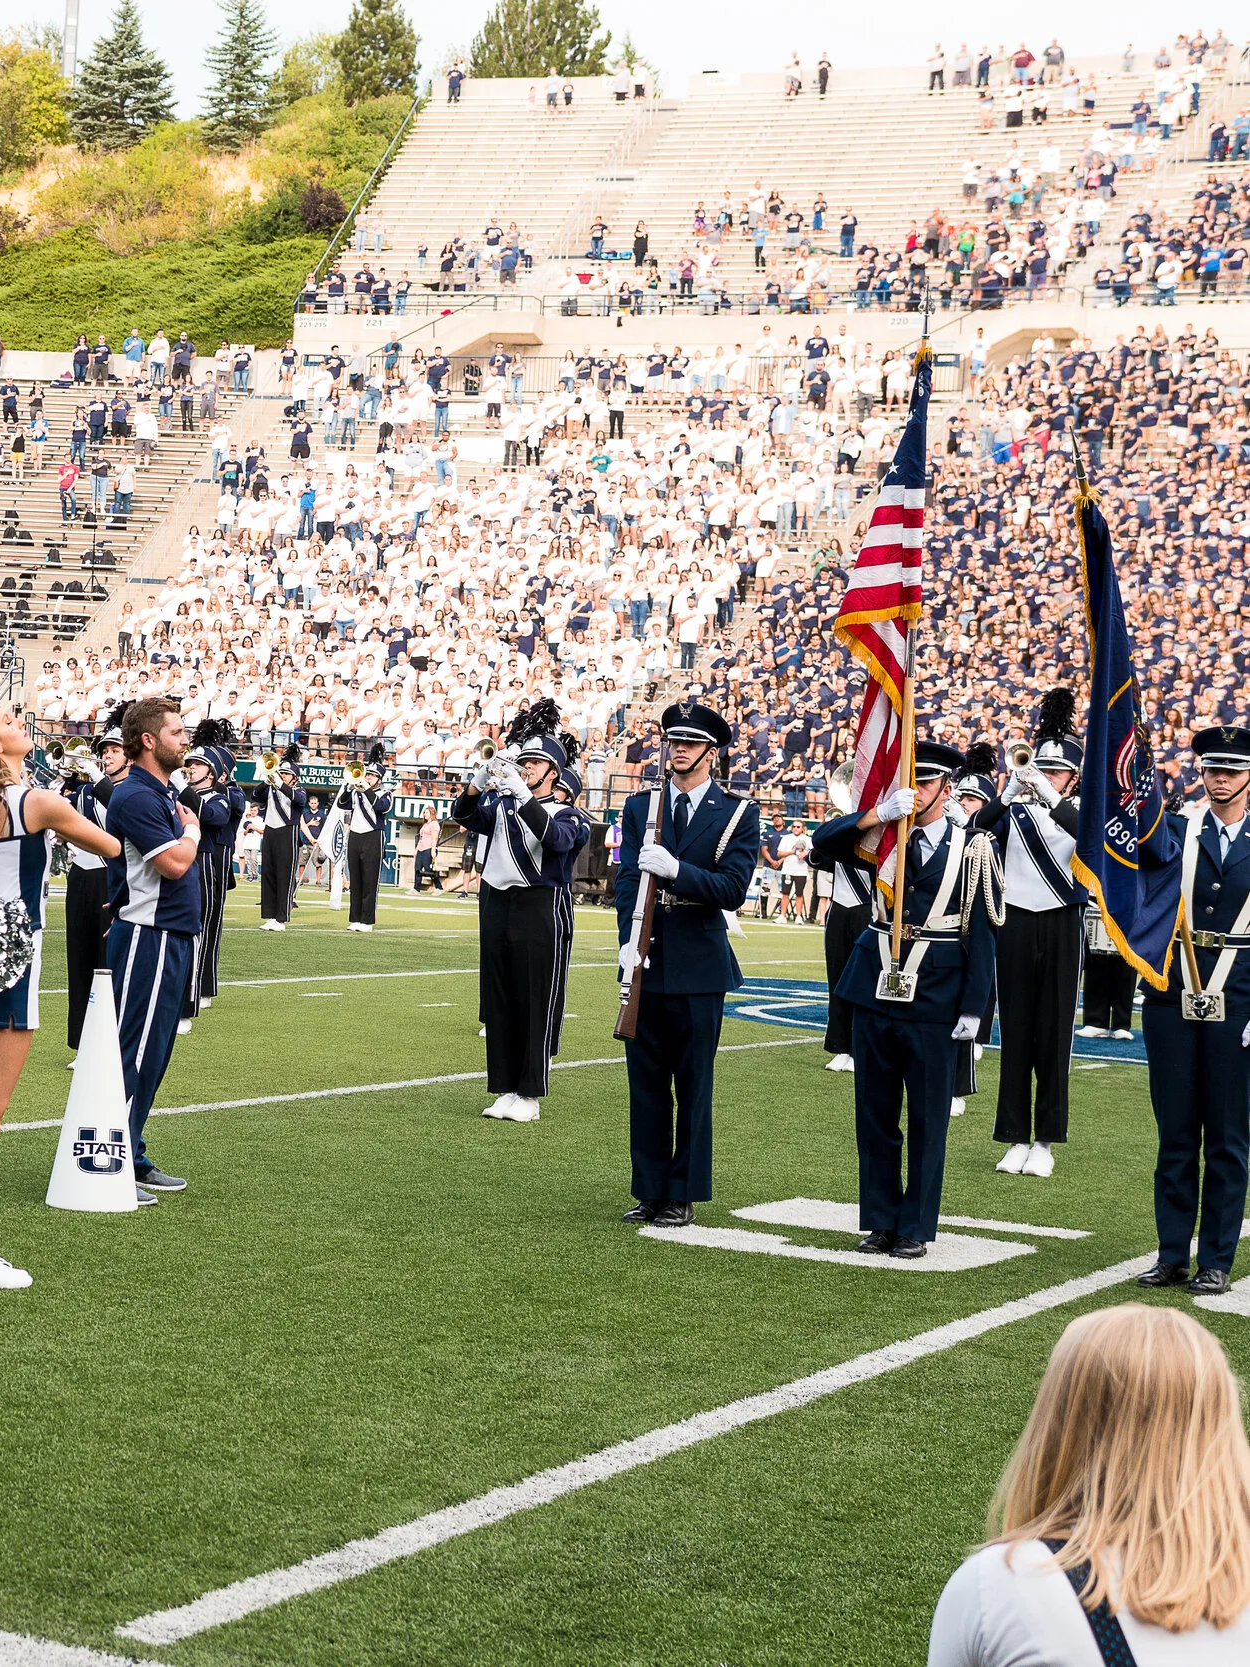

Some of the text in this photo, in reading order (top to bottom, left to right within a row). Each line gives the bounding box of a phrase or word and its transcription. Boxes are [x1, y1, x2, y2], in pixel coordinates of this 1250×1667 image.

[298, 776, 327, 784] ANCIAL
[394, 798, 452, 820] UTAH
[1104, 815, 1138, 853] 1896
[73, 1142, 127, 1160] STATE
